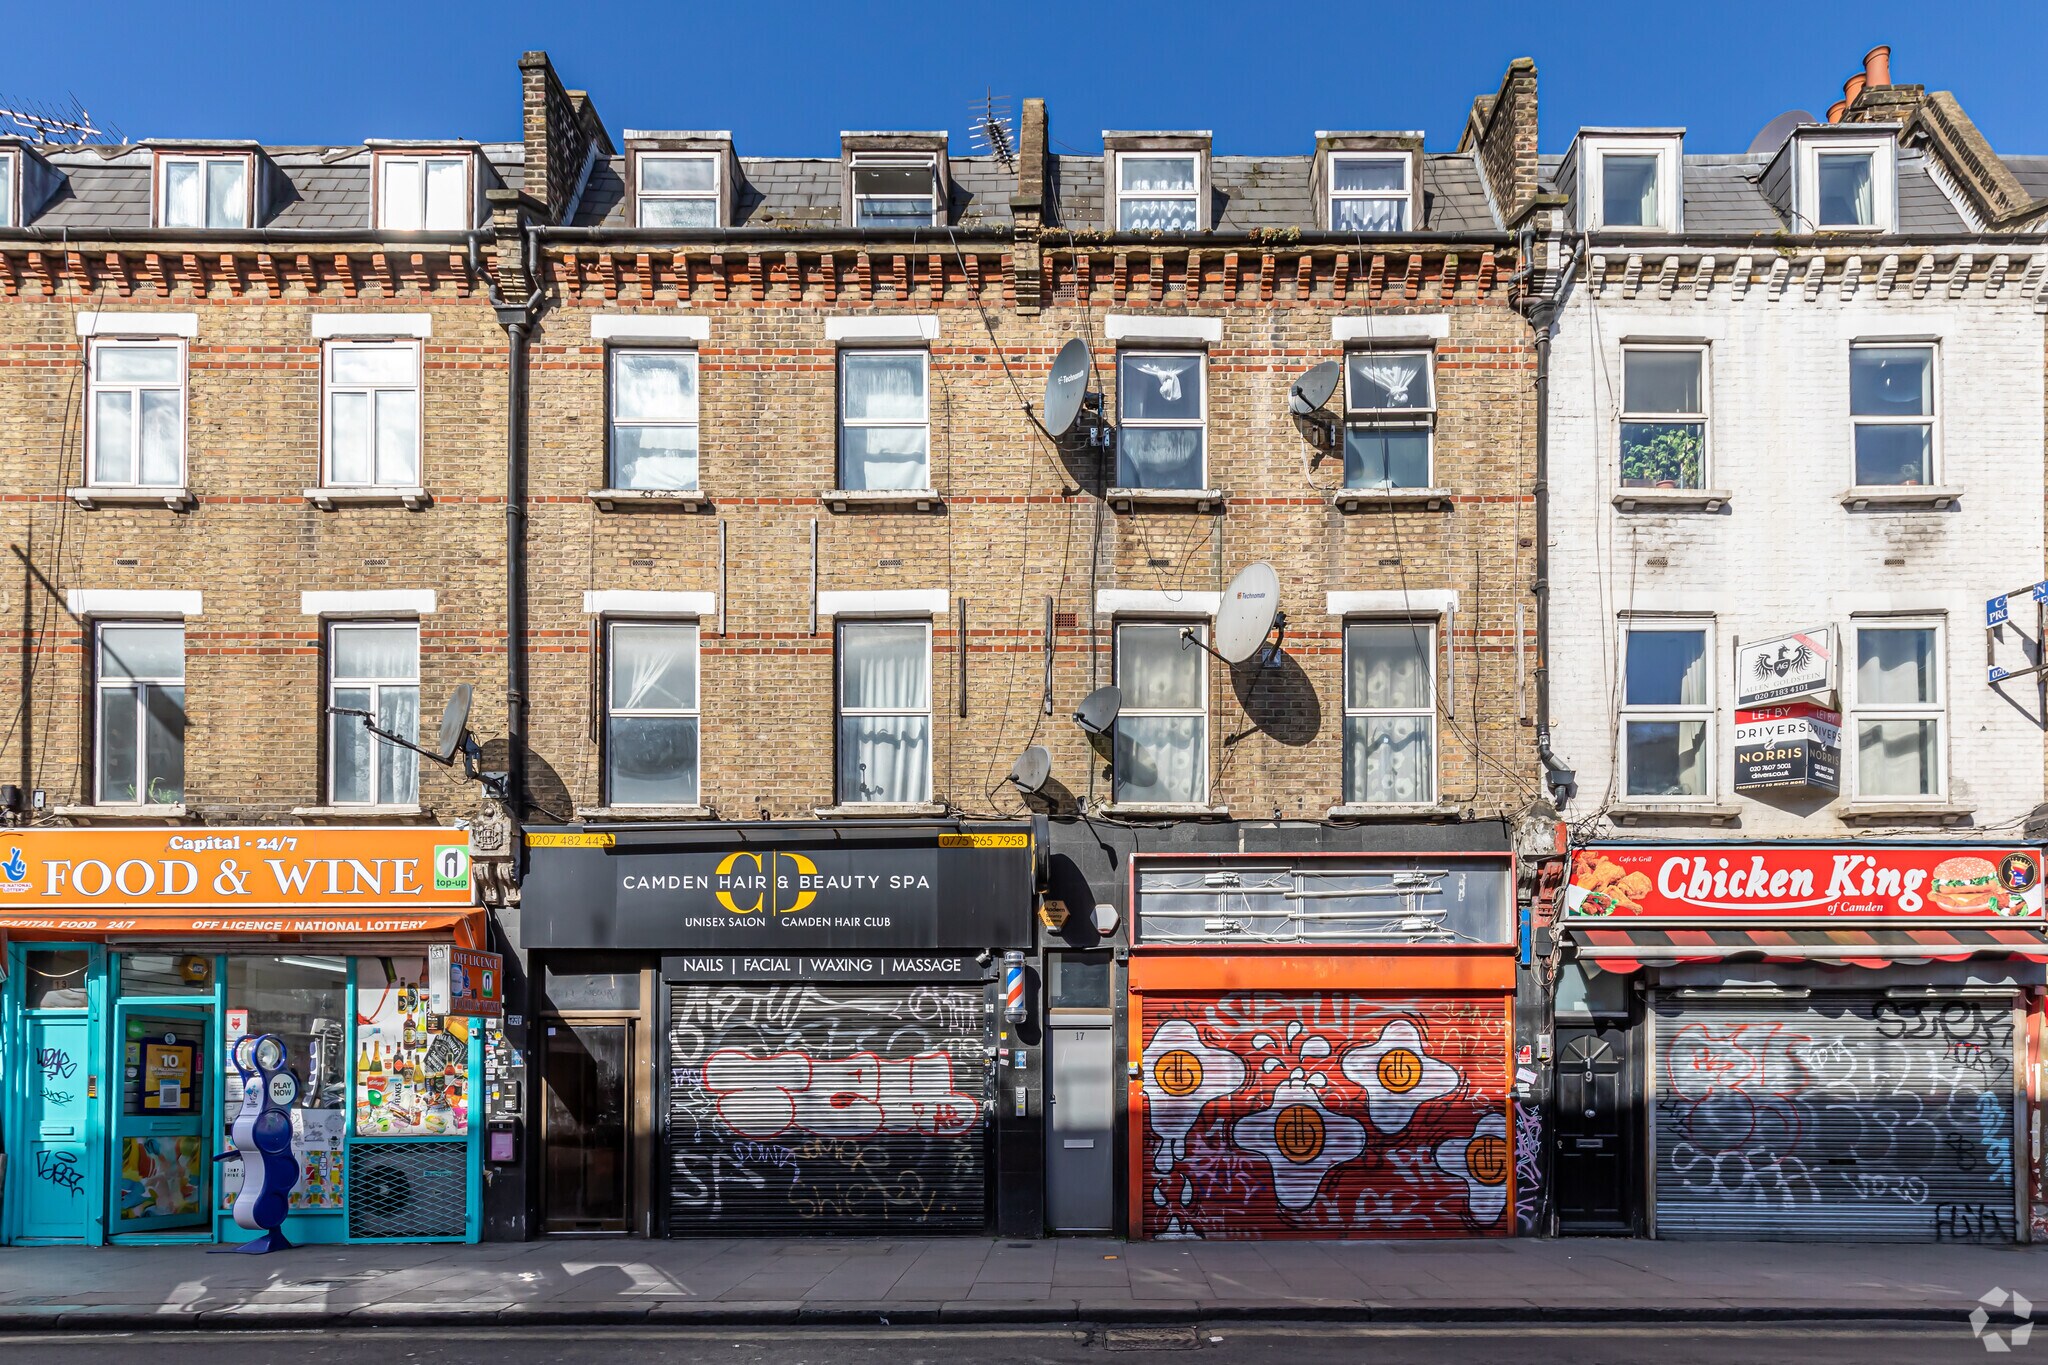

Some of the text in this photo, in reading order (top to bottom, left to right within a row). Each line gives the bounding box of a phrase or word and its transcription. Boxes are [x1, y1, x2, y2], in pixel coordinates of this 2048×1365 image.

[1776, 661, 1789, 671] AG
[1745, 672, 1821, 694] ALLEN GOLDSTEIN
[1754, 684, 1809, 701] 020 7183 4101
[1752, 707, 1791, 720] LET BY
[1817, 709, 1836, 723] LET BY
[1737, 723, 1806, 739] DRIVERS
[1808, 722, 1842, 742] DRIVERS
[1740, 747, 1802, 763] NORRIS
[1809, 748, 1840, 766] NORRIS
[169, 835, 241, 853] Capital
[256, 836, 298, 852] 24/7
[529, 835, 556, 846] 0207
[560, 835, 581, 846] 482
[942, 836, 1024, 846] 0775 965 7958
[40, 857, 424, 897] FOOD & WINE
[436, 878, 467, 888] top-up
[623, 875, 930, 890] CAMDEN HAIR & BEAUTY SPA
[1657, 854, 1928, 912] Chicken King
[1827, 901, 1884, 915] of Camden
[0, 919, 54, 928] CAPITAL
[58, 920, 97, 929] FOOD
[106, 920, 136, 929] 24/7
[192, 920, 219, 930] OFF
[222, 920, 283, 930] LICENCE
[294, 921, 363, 931] NATIONAL
[367, 920, 428, 930] LOTTERY
[685, 917, 891, 927] UNISEX SALON CAMDEN HAIR CLUB
[453, 952, 468, 965] OFF
[469, 954, 499, 970] LICENCE
[683, 958, 724, 972] NAILS
[743, 958, 791, 972] FACIAL
[810, 958, 873, 972] WAXING
[892, 958, 961, 972] MASSAGE
[56, 980, 67, 989] 13
[1075, 1032, 1085, 1041] 17
[161, 1054, 179, 1068] 10
[273, 1089, 292, 1097] NOW
[394, 1082, 402, 1104] FLAKES
